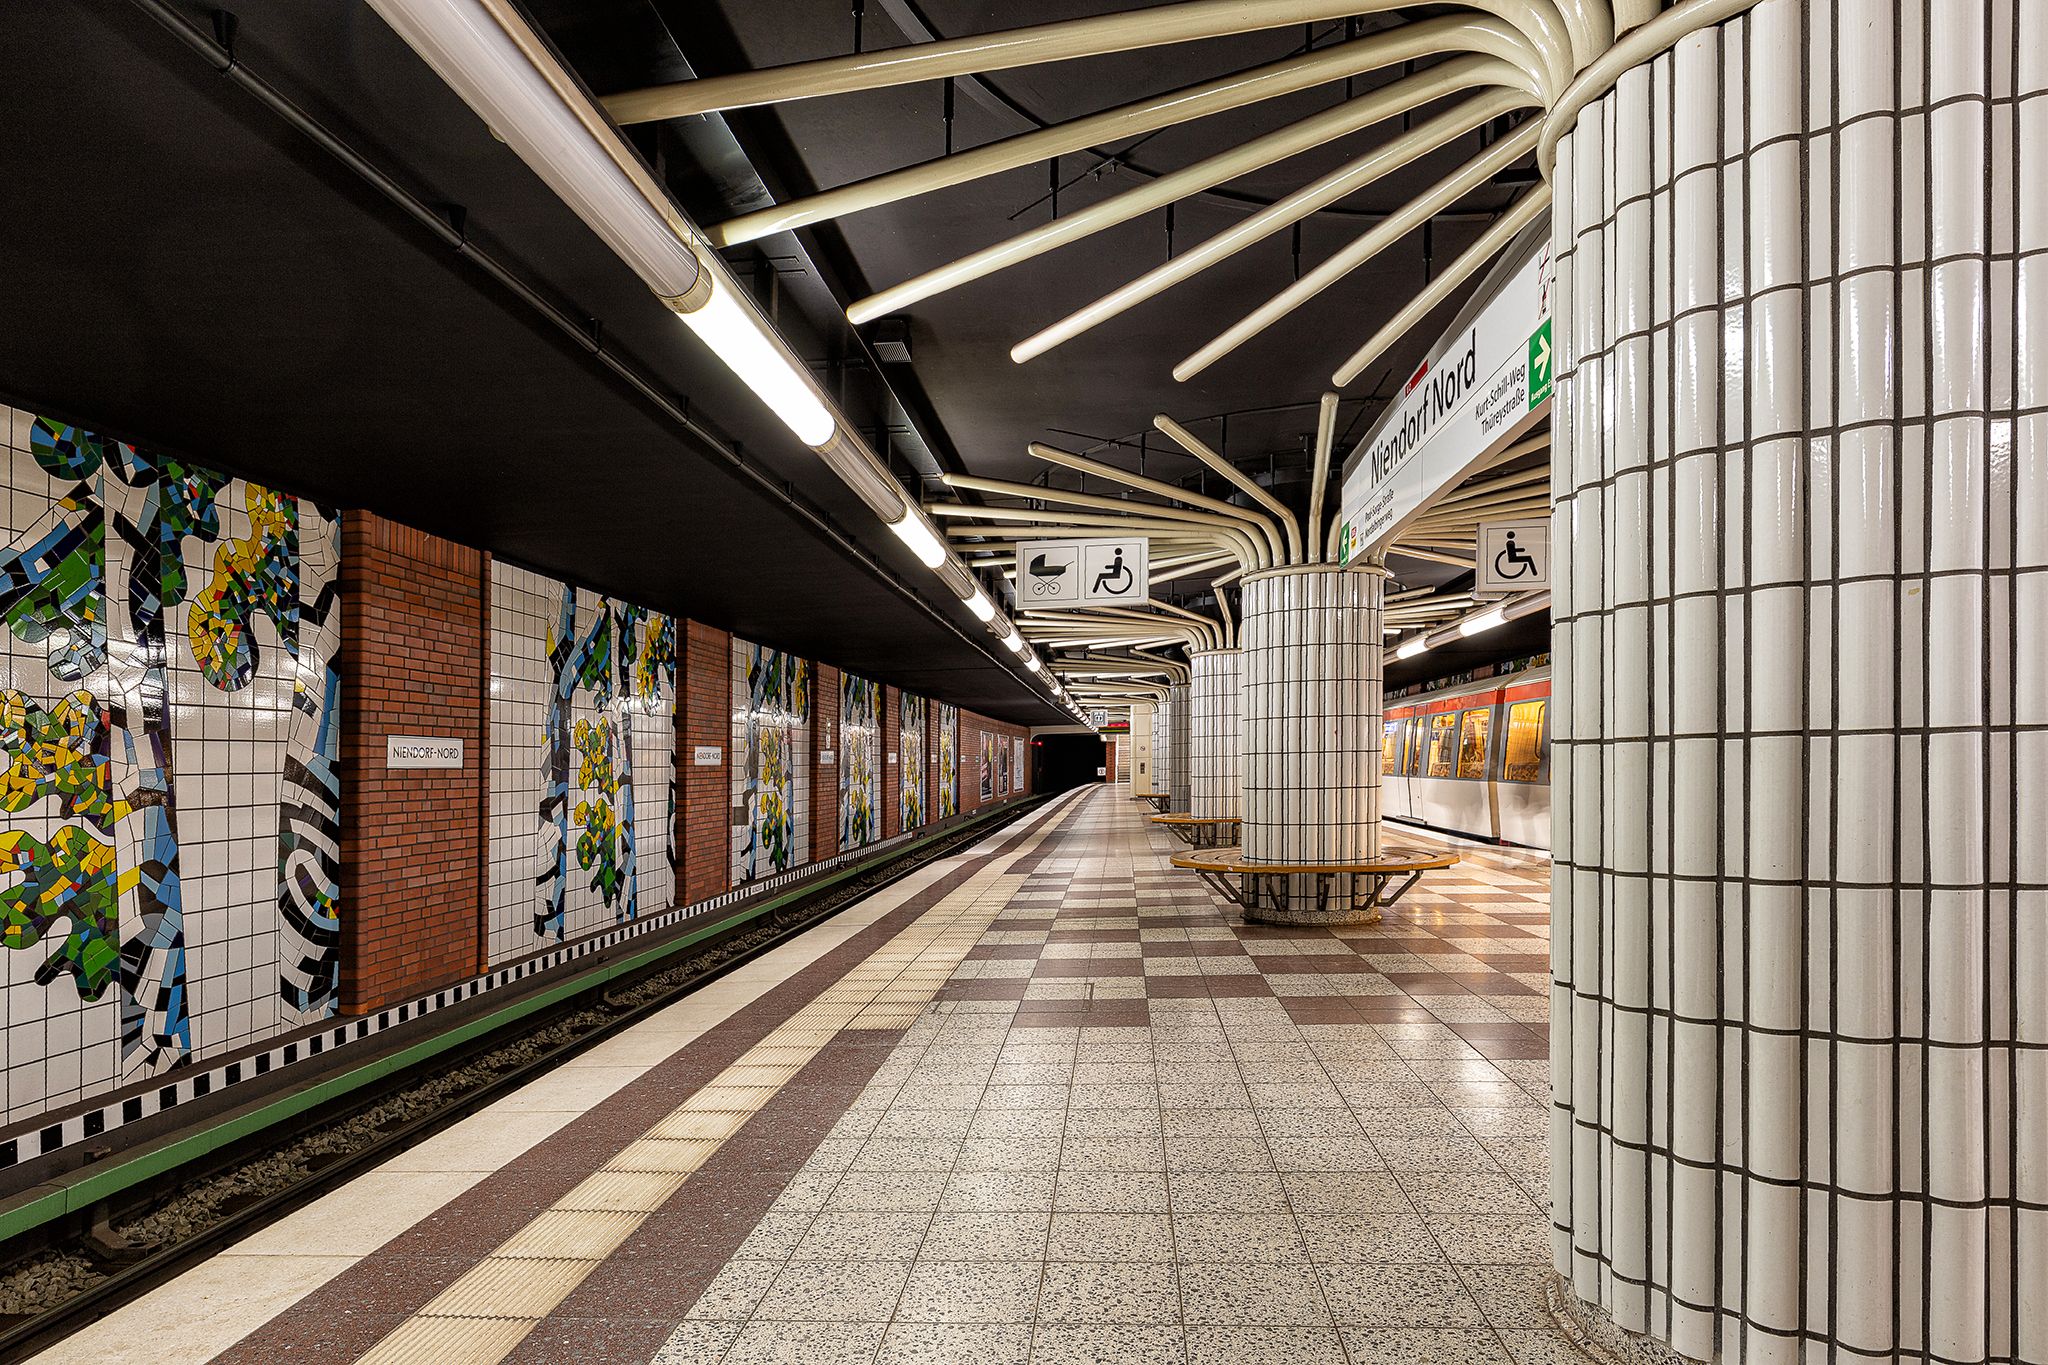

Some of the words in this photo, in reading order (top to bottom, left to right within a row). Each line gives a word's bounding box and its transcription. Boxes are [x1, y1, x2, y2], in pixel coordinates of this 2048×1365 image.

[1370, 383, 1430, 489] Niendorf
[1432, 327, 1476, 426] Nord
[1475, 363, 1526, 421] Kurt-Schill-Weg
[1481, 387, 1525, 436] Thüreystraße
[393, 746, 459, 759] NIENDORF-NORD
